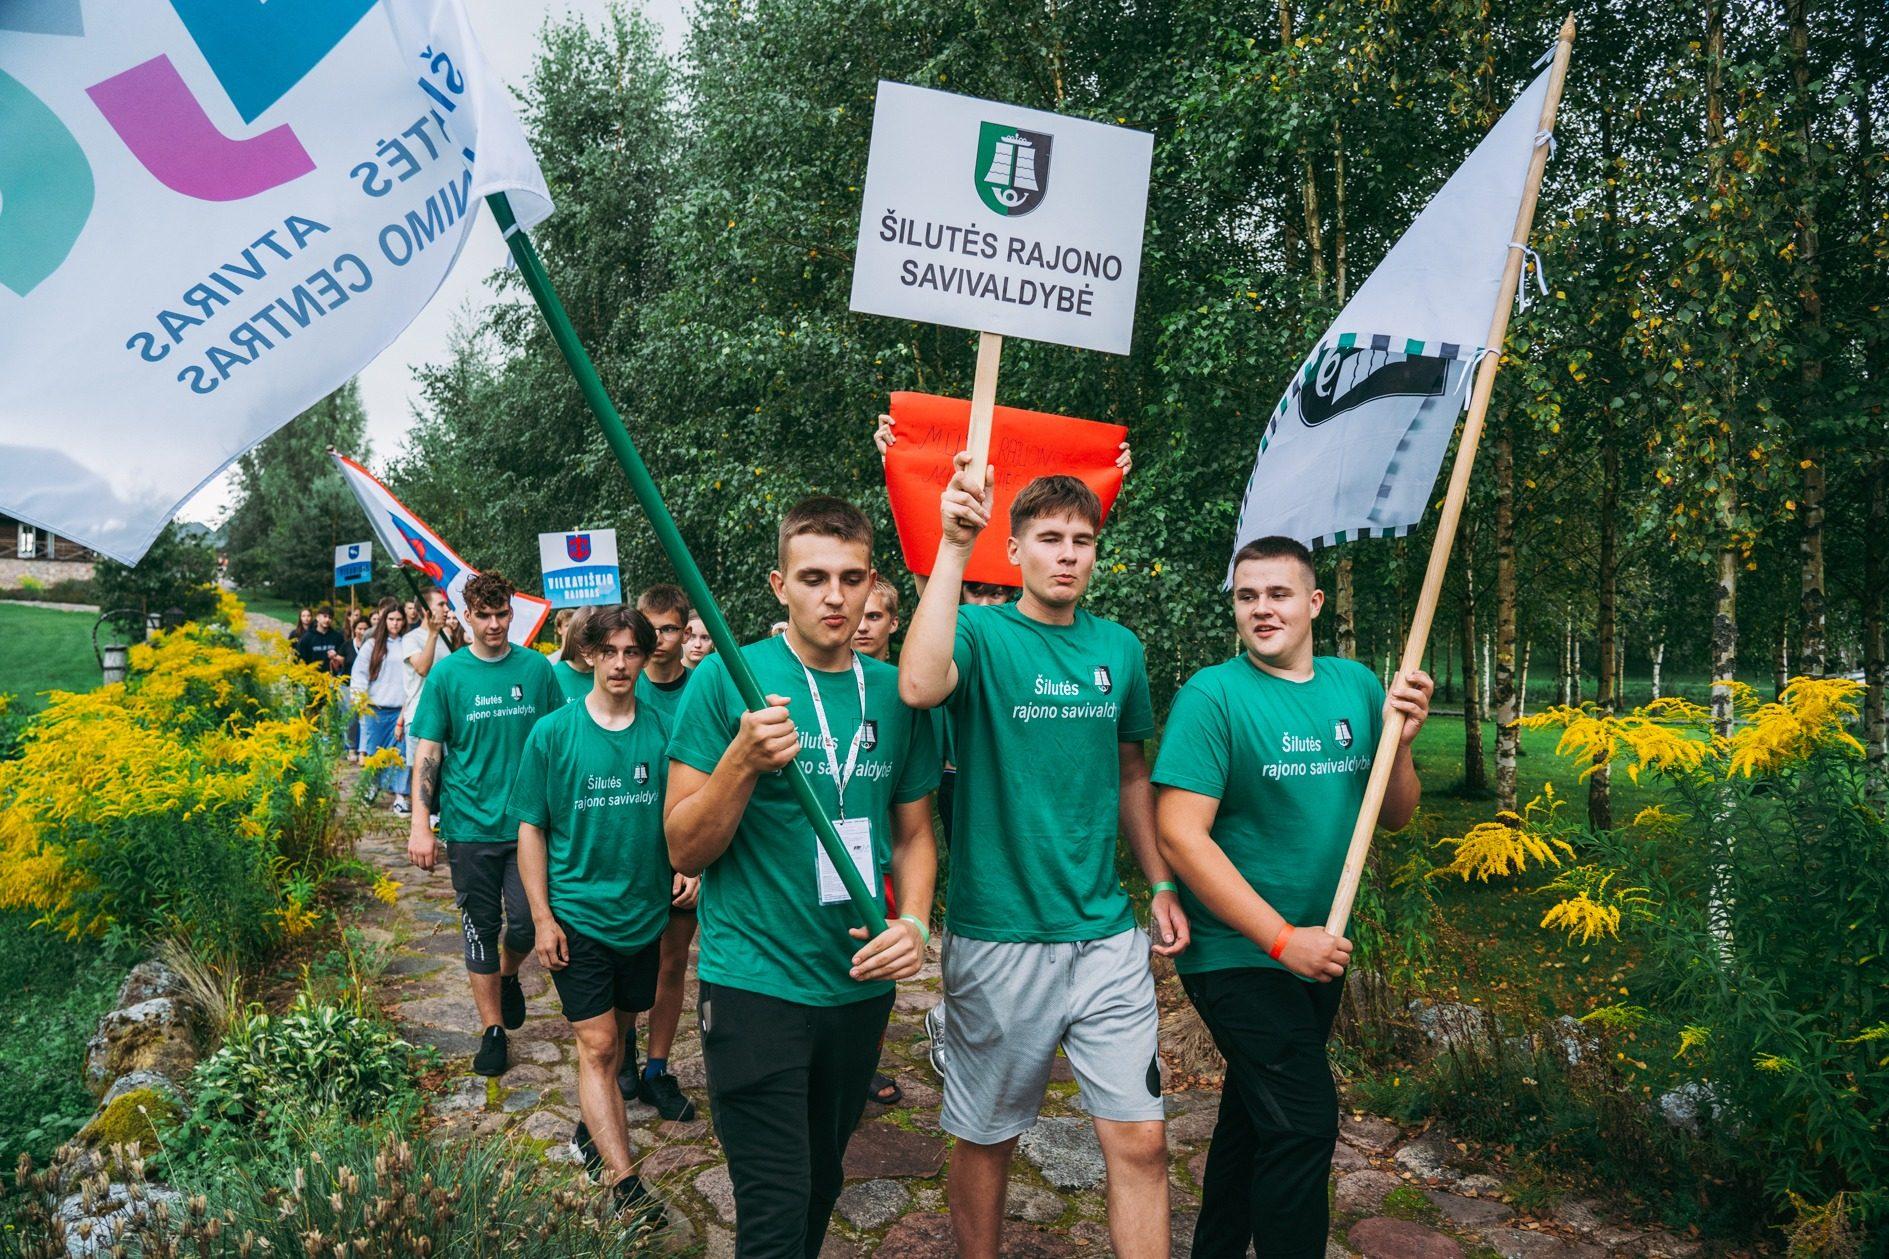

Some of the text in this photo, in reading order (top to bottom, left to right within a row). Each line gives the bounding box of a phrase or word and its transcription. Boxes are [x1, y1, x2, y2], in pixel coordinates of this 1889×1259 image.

[880, 209, 1122, 281] ŠILUTĖS RAJONO
[900, 260, 1094, 316] SAVIVALDYBĖ
[1034, 674, 1079, 696] Šilutės
[475, 695, 503, 706] Šilutės
[466, 710, 491, 723] rajono
[1012, 702, 1058, 722] rajono
[1282, 732, 1322, 752] Šilutės
[1262, 760, 1306, 780] rajono
[588, 775, 622, 789] Šilutės
[574, 796, 606, 811] rajono
